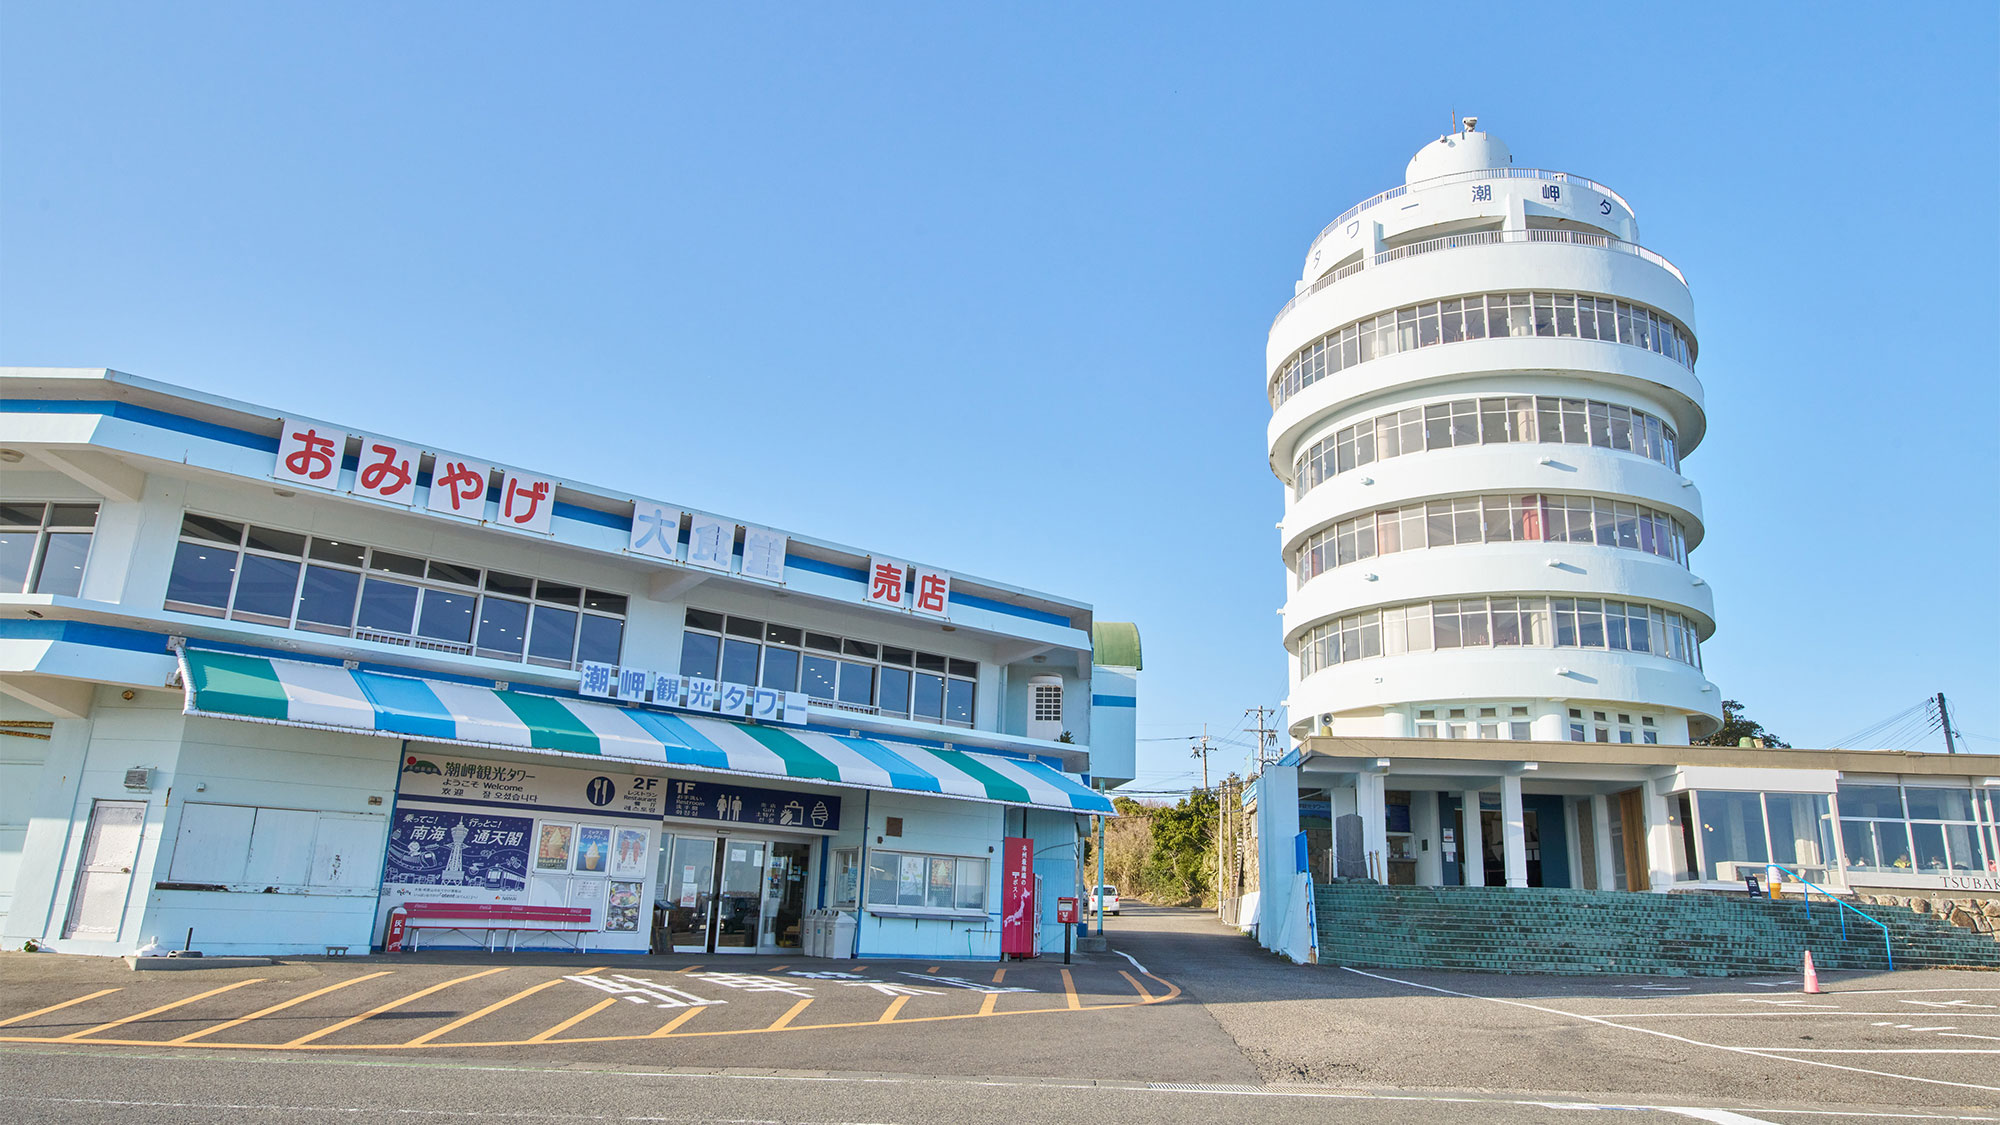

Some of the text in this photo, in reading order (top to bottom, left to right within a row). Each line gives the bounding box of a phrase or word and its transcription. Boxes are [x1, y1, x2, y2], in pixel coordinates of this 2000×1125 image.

[286, 428, 550, 524] おみやげ
[635, 508, 781, 578] 大食堂
[873, 563, 946, 612] 売店
[583, 664, 806, 716] 潮岬観光タワー
[444, 761, 536, 783] 潮岬観光タワー
[442, 779, 523, 792] ようこそ Welcome
[633, 777, 659, 791] 2F
[676, 782, 696, 795] 1F
[624, 795, 657, 803] Restaurant
[408, 825, 448, 841] 南海
[471, 829, 524, 847] 通天閣
